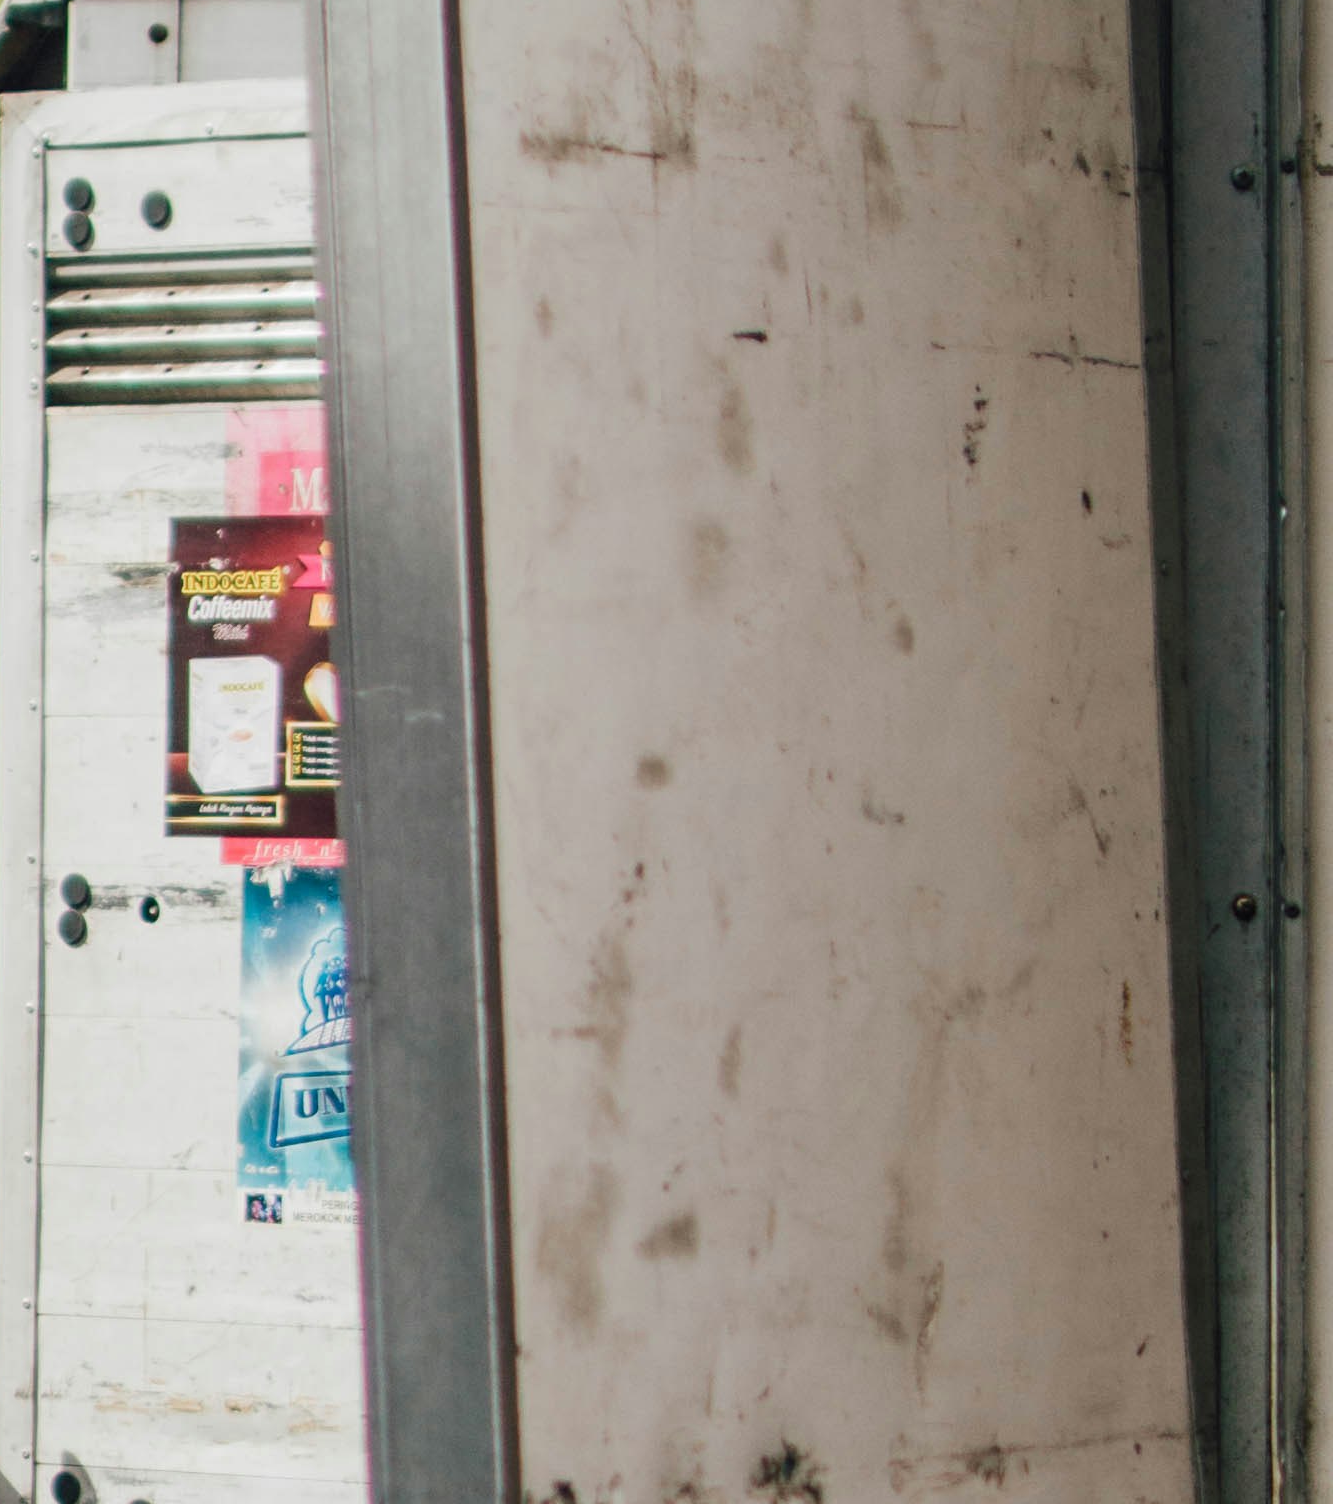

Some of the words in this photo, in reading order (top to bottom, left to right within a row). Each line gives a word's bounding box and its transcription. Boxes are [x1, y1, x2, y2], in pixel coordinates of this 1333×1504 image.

[181, 566, 281, 593] INDOCAFÉ
[188, 595, 276, 621] Coffeemix
[252, 839, 302, 860] fresh
